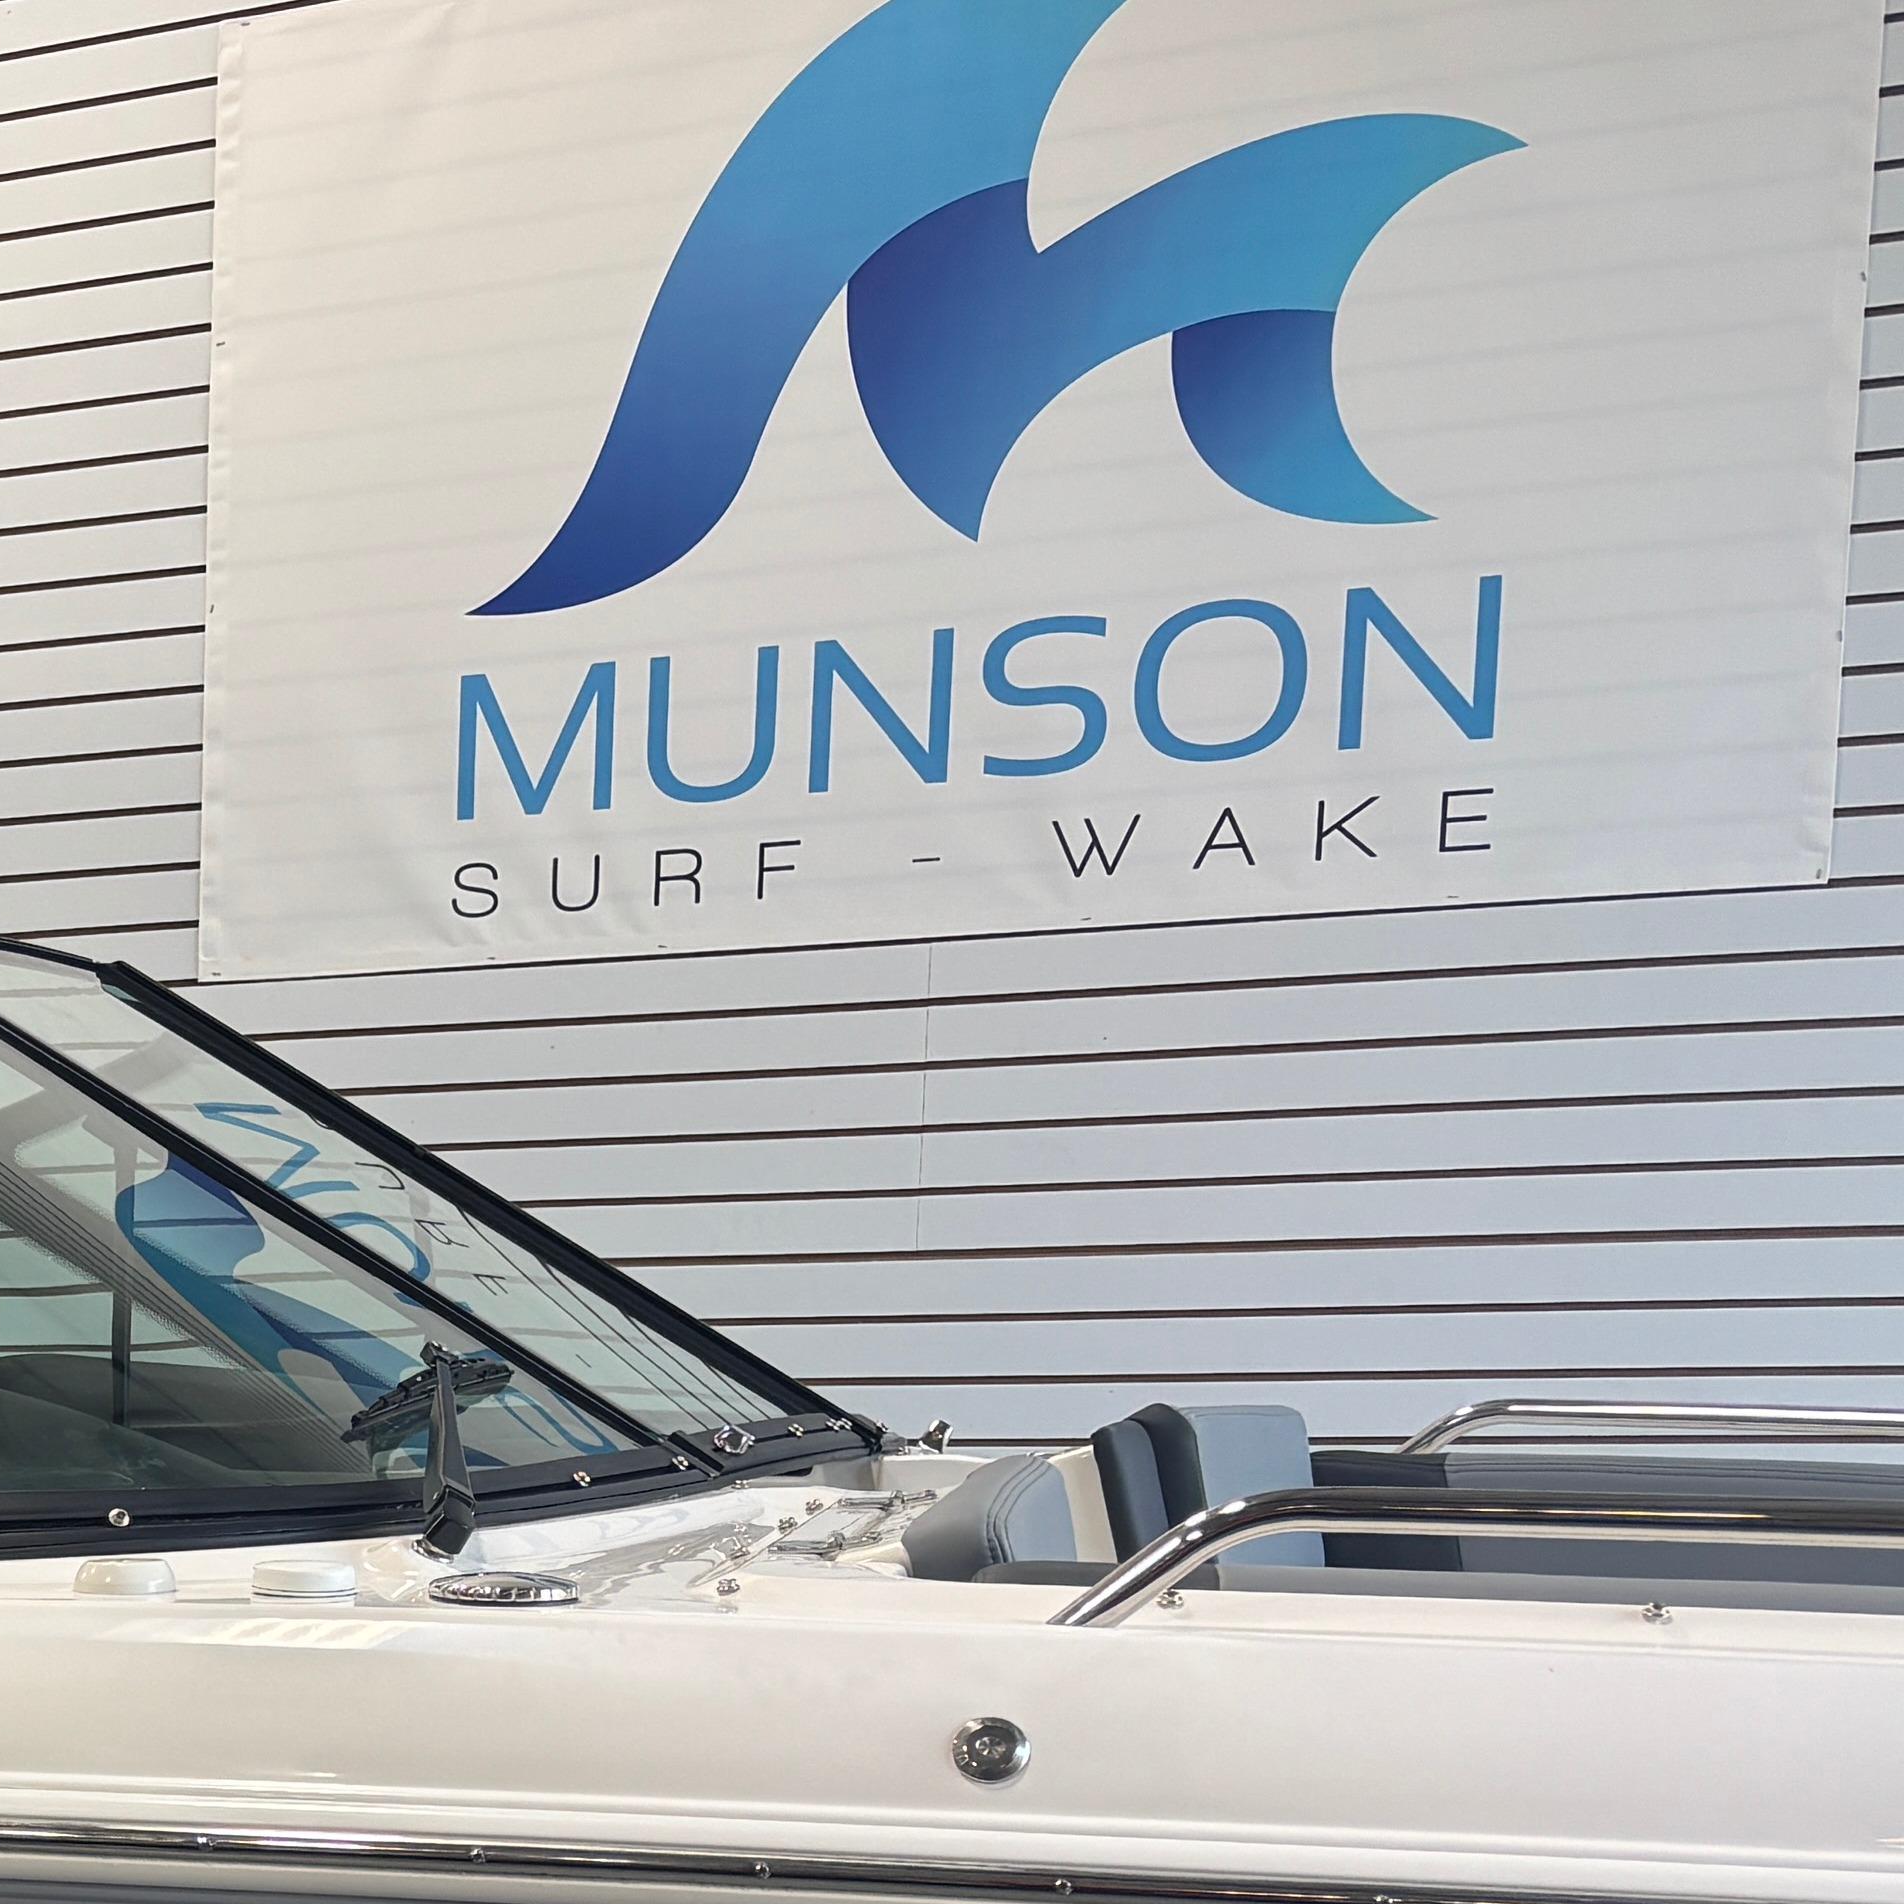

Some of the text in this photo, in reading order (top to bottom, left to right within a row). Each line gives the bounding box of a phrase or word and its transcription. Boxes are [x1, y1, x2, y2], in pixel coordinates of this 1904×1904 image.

[457, 574, 1502, 820] MUNSON
[452, 839, 801, 918] SURF
[1052, 788, 1494, 877] WAKE
